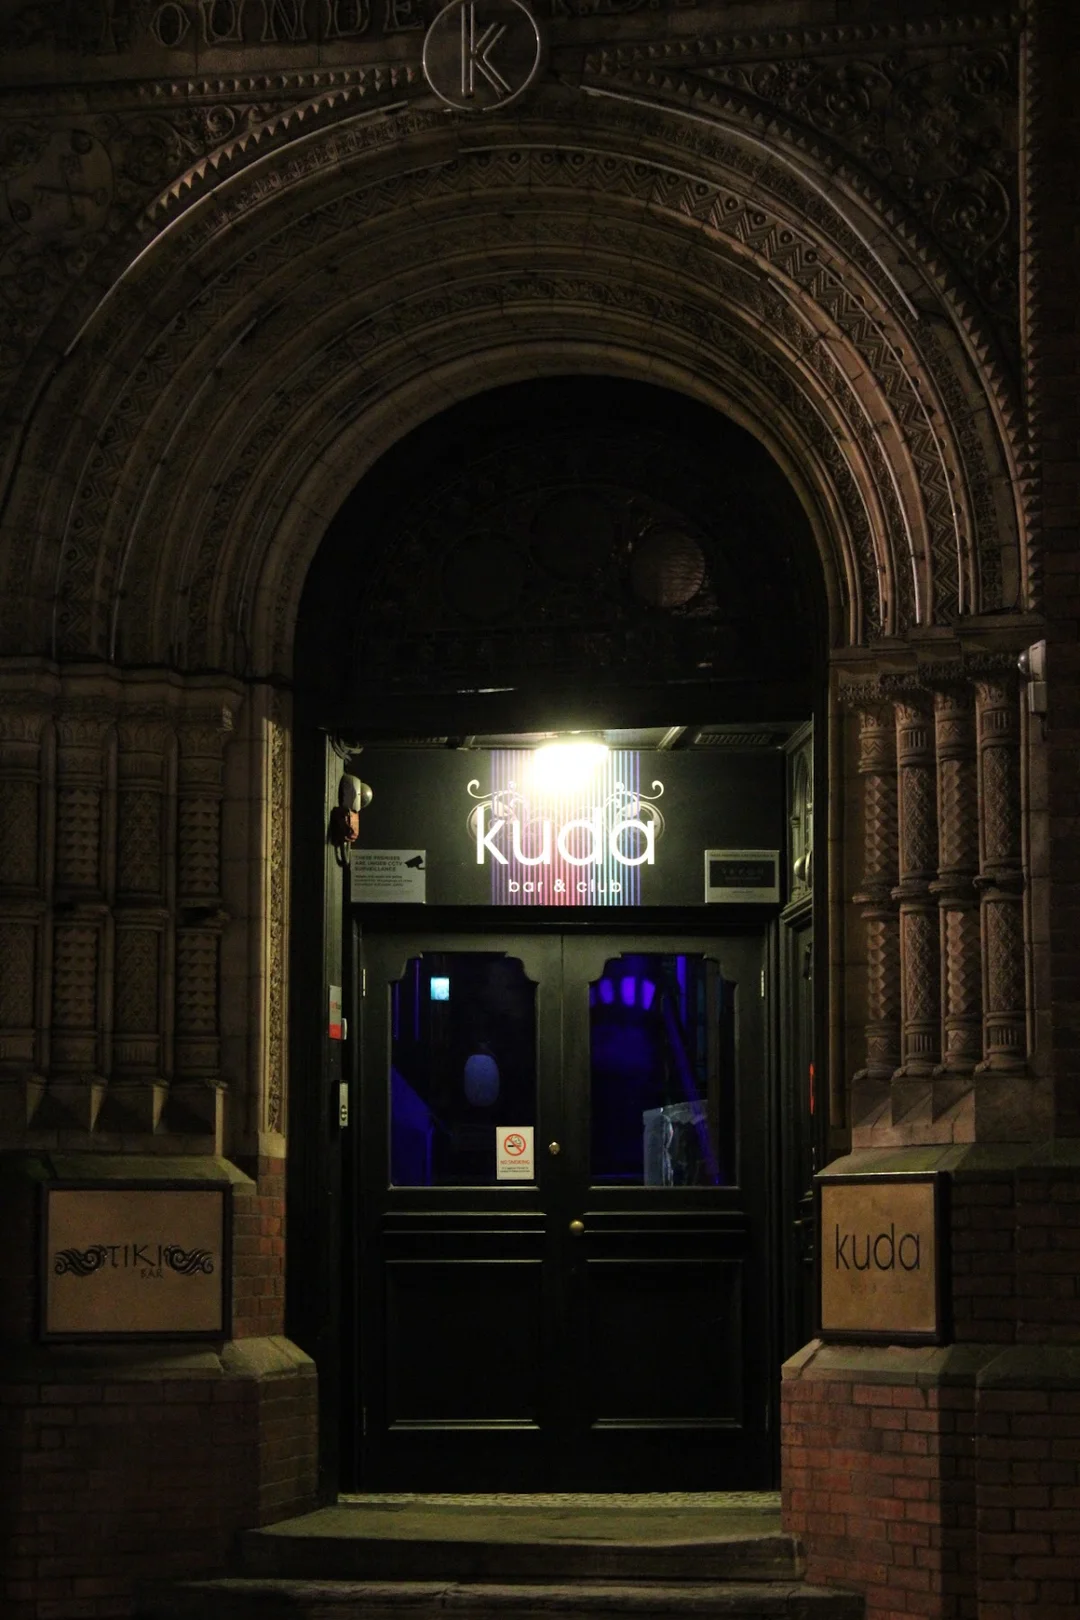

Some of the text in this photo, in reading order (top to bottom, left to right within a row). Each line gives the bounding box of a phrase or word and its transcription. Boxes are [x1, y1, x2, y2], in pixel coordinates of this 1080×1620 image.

[476, 806, 655, 866] kuda
[508, 879, 622, 893] bar & club
[107, 1244, 162, 1268] TIKI
[835, 1223, 920, 1271] kuda
[140, 1268, 163, 1279] BAR
